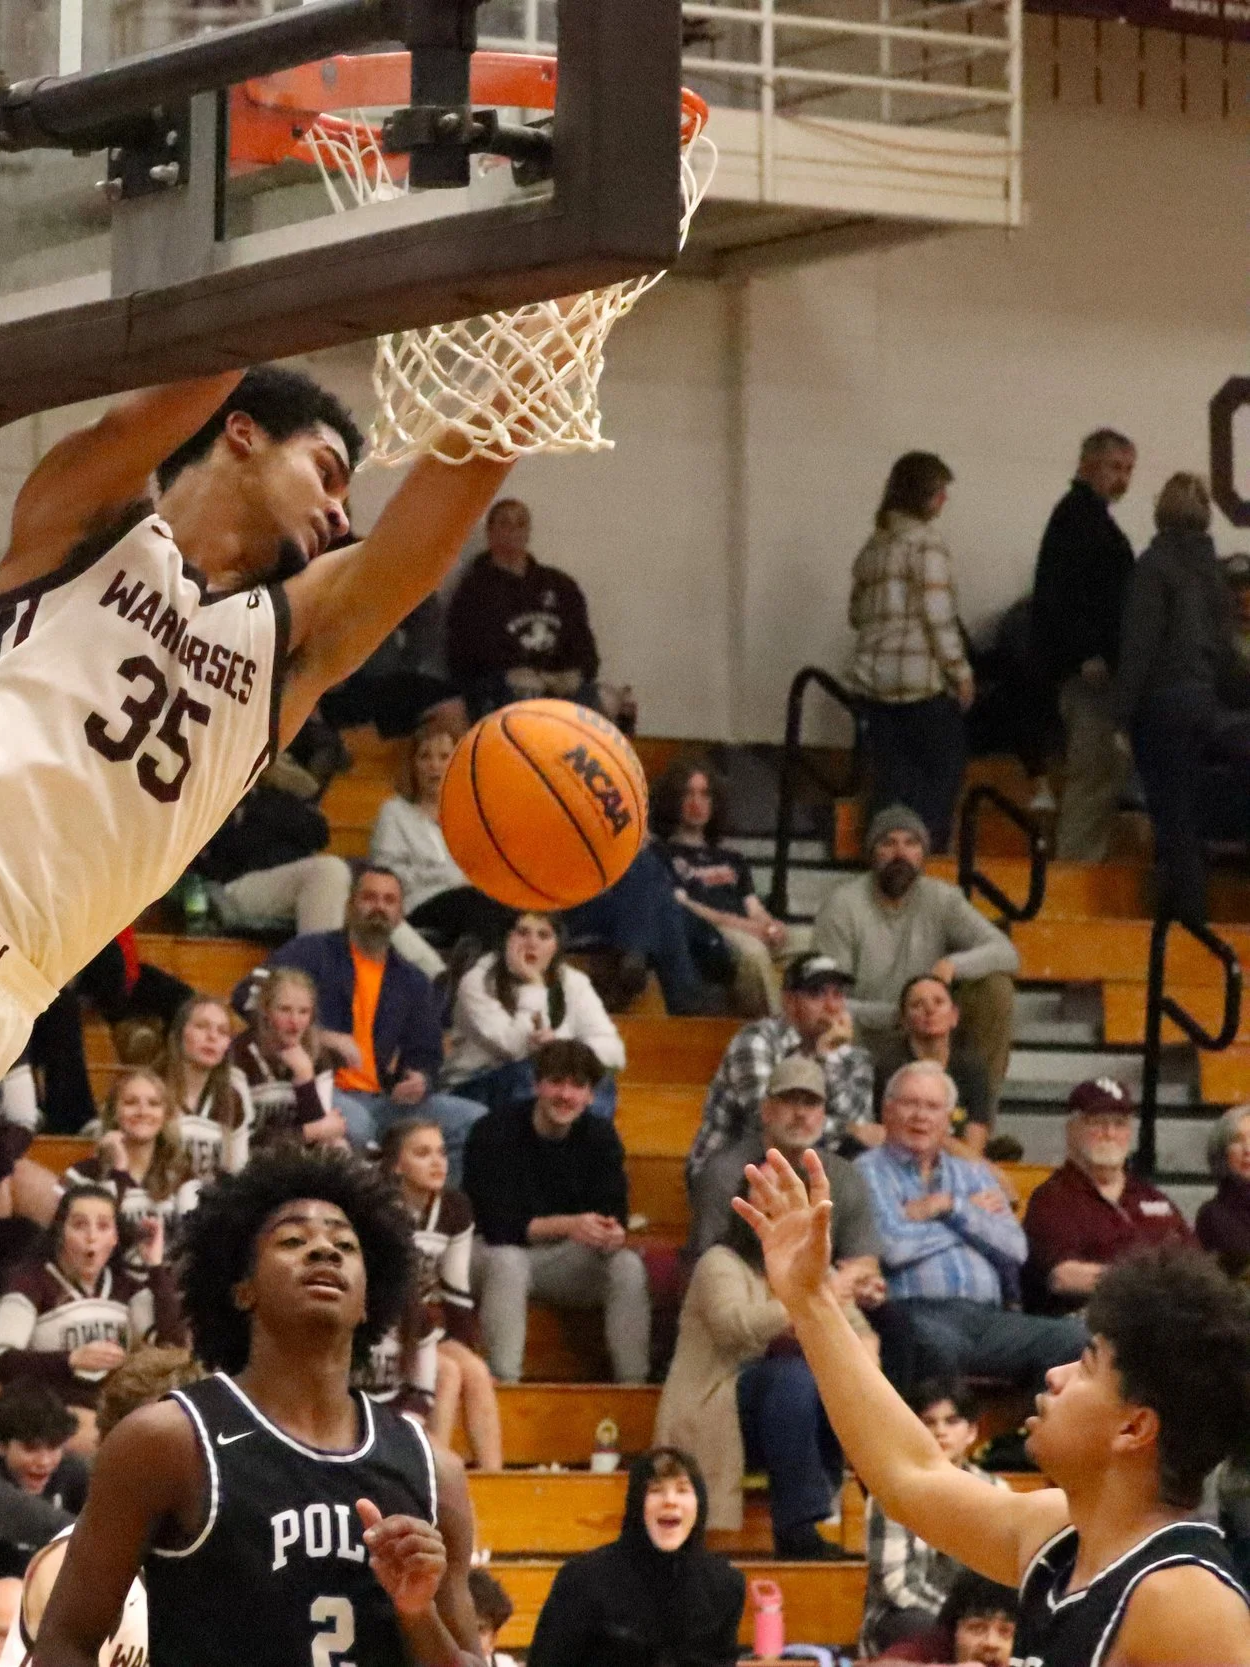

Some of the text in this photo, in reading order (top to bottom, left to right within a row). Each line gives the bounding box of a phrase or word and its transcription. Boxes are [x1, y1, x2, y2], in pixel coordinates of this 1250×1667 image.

[83, 654, 212, 804] 35
[562, 744, 631, 838] NCAA
[270, 1503, 367, 1572] POL
[310, 1595, 357, 1667] 2
